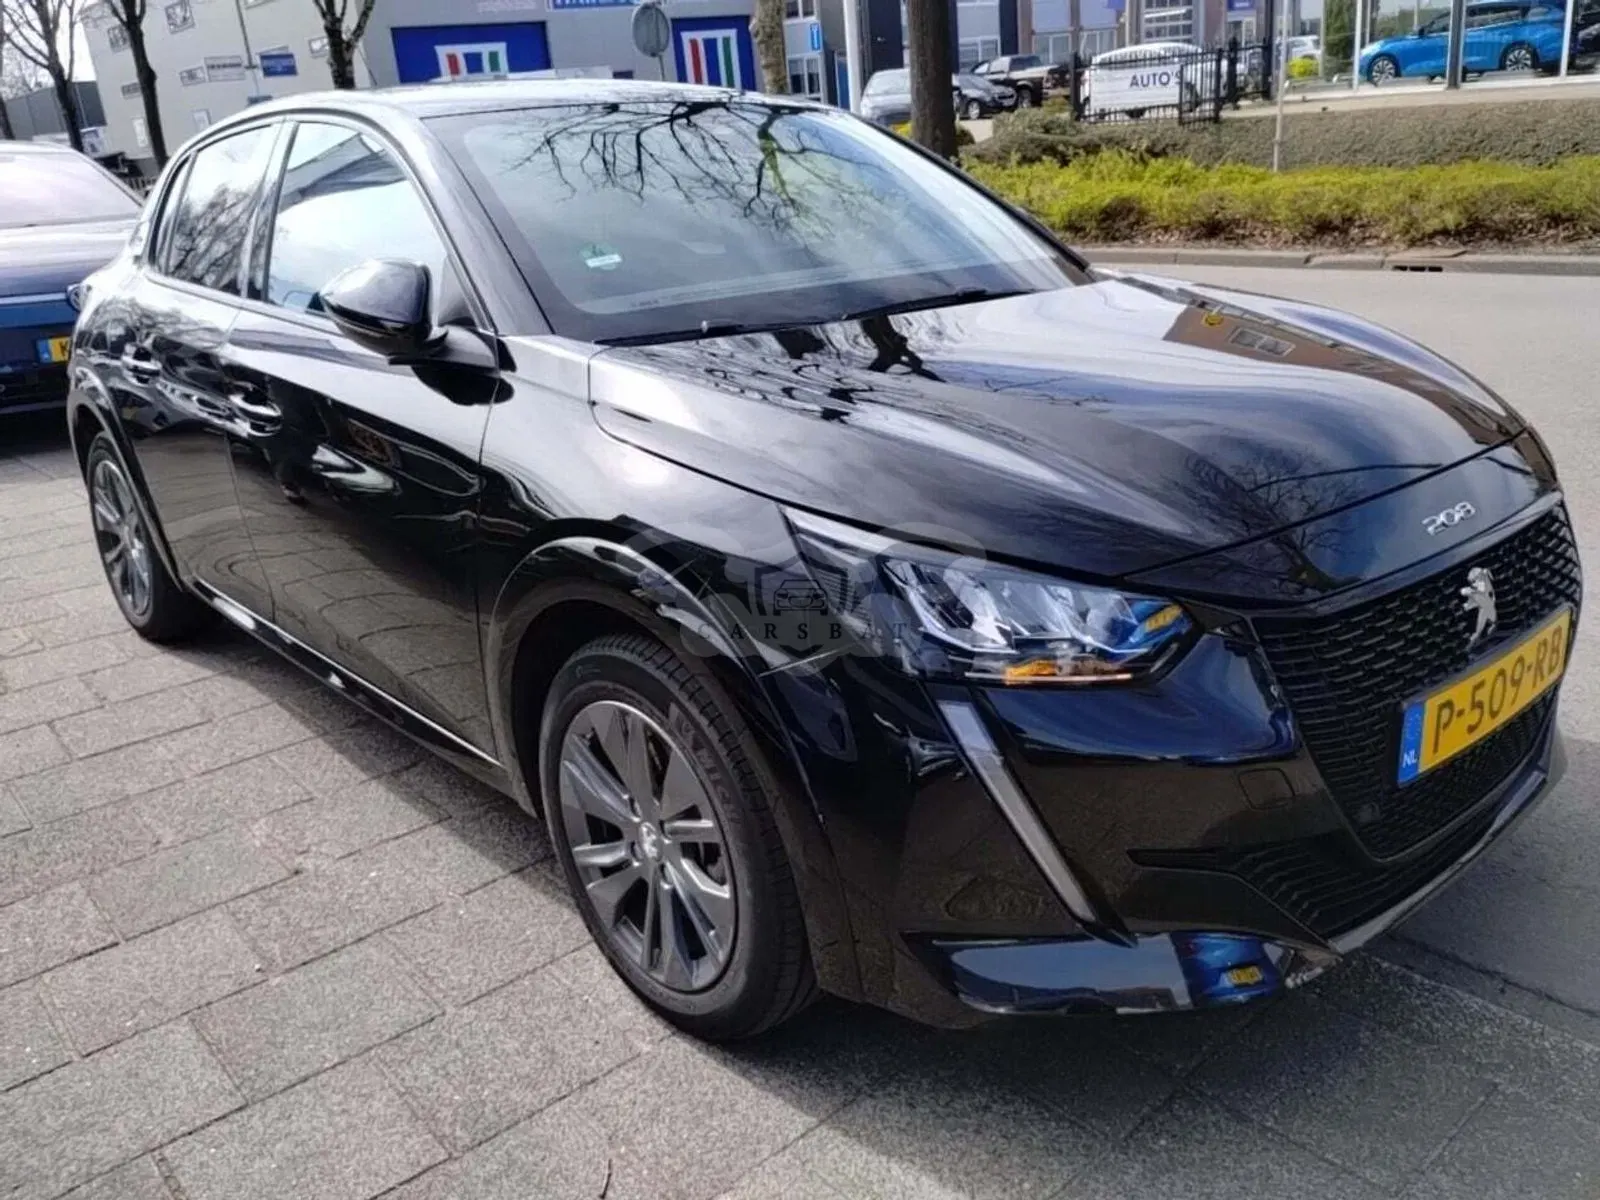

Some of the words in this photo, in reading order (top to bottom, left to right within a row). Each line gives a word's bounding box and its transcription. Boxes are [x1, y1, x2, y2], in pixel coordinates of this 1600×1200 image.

[1421, 501, 1476, 535] 208
[1432, 624, 1563, 755] P-509-RB
[1402, 750, 1418, 769] NL
